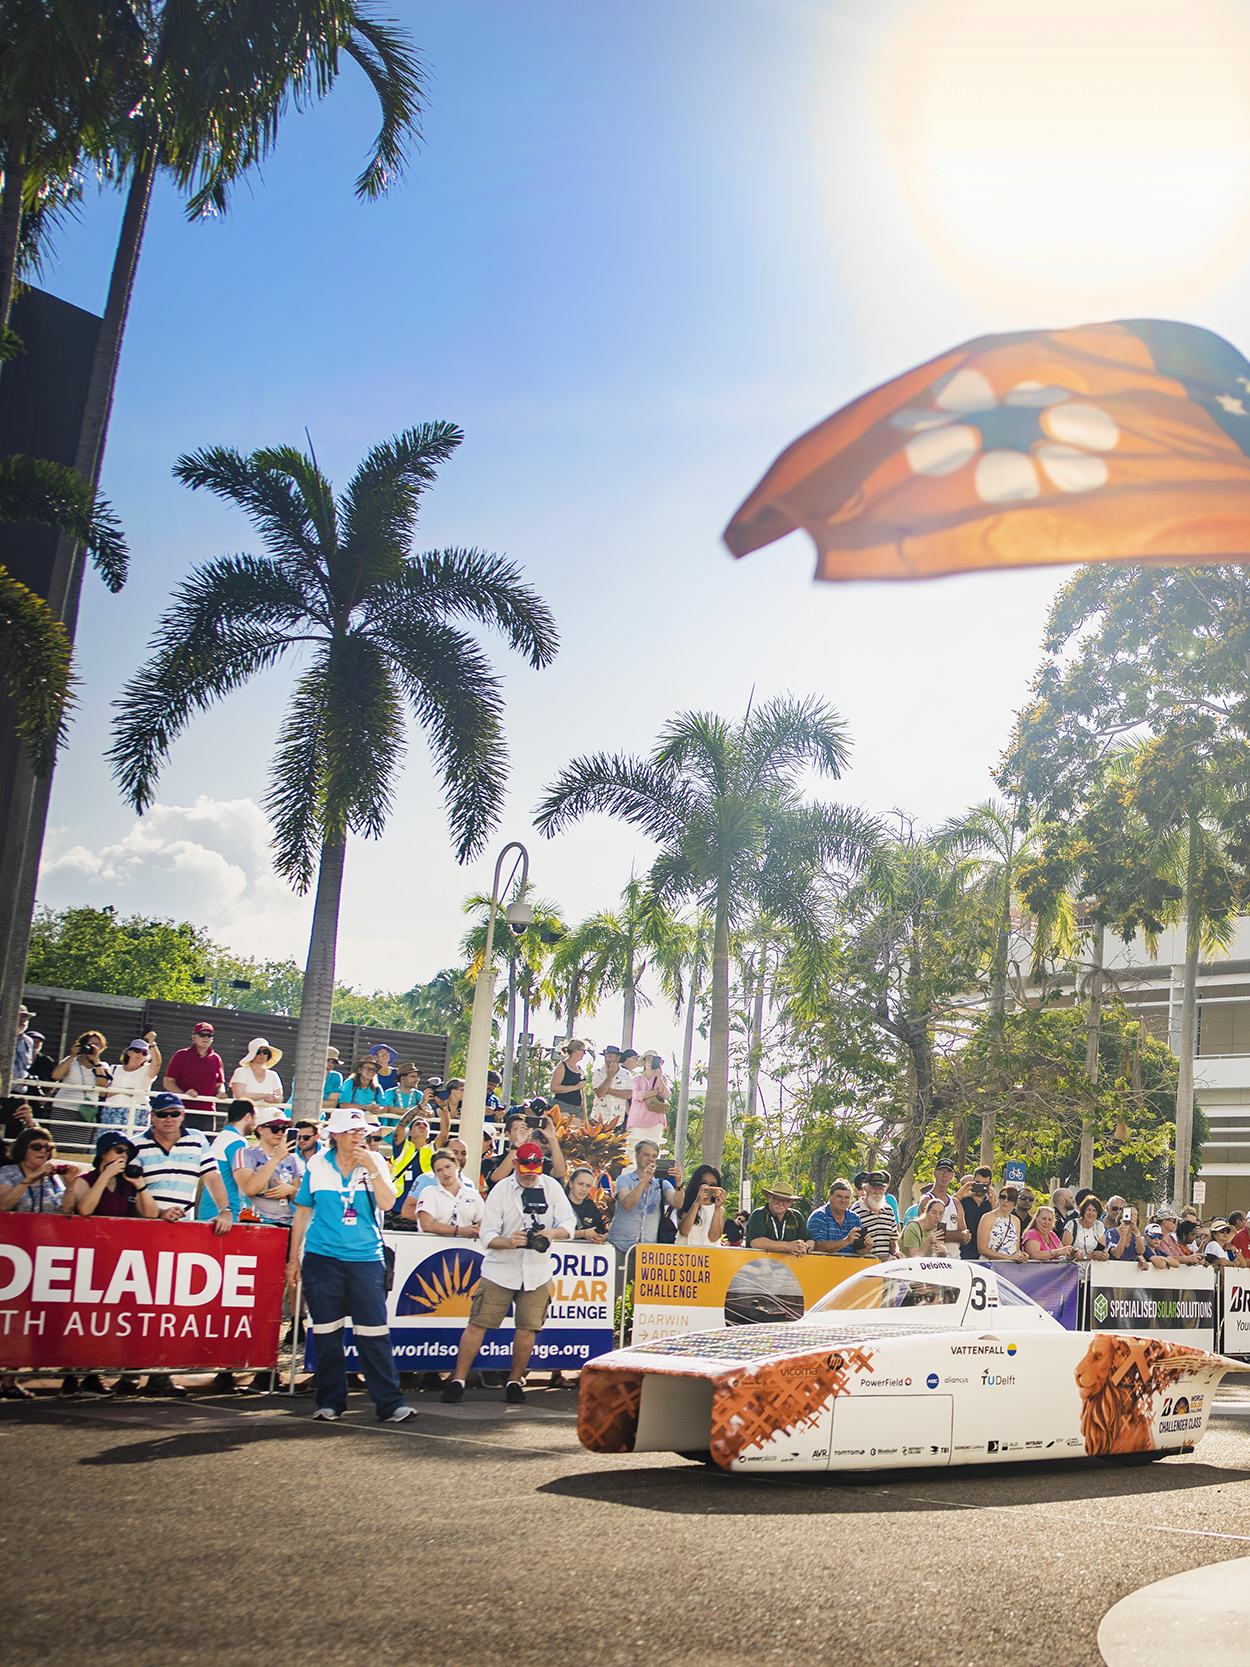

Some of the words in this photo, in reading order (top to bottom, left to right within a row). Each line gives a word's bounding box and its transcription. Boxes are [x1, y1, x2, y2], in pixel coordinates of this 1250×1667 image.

[550, 1253, 609, 1277] ORLD
[641, 1251, 710, 1268] BRIDGESTONE
[641, 1267, 676, 1282] WORLD
[679, 1269, 711, 1284] SOLAR
[550, 1279, 608, 1302] LAR
[640, 1283, 698, 1299] CHALLENGE
[971, 1276, 987, 1311] 3
[546, 1305, 607, 1320] LLENGE
[638, 1313, 689, 1326] DARWIN
[63, 1311, 253, 1339] AUSTRALIA
[950, 1345, 1005, 1355] VATTENFALL
[780, 1367, 818, 1377] vicoma
[944, 1376, 969, 1384] aliancys
[860, 1378, 904, 1387] PowerField
[1158, 1418, 1188, 1434] CHALLENGER
[1188, 1417, 1202, 1430] CLASS
